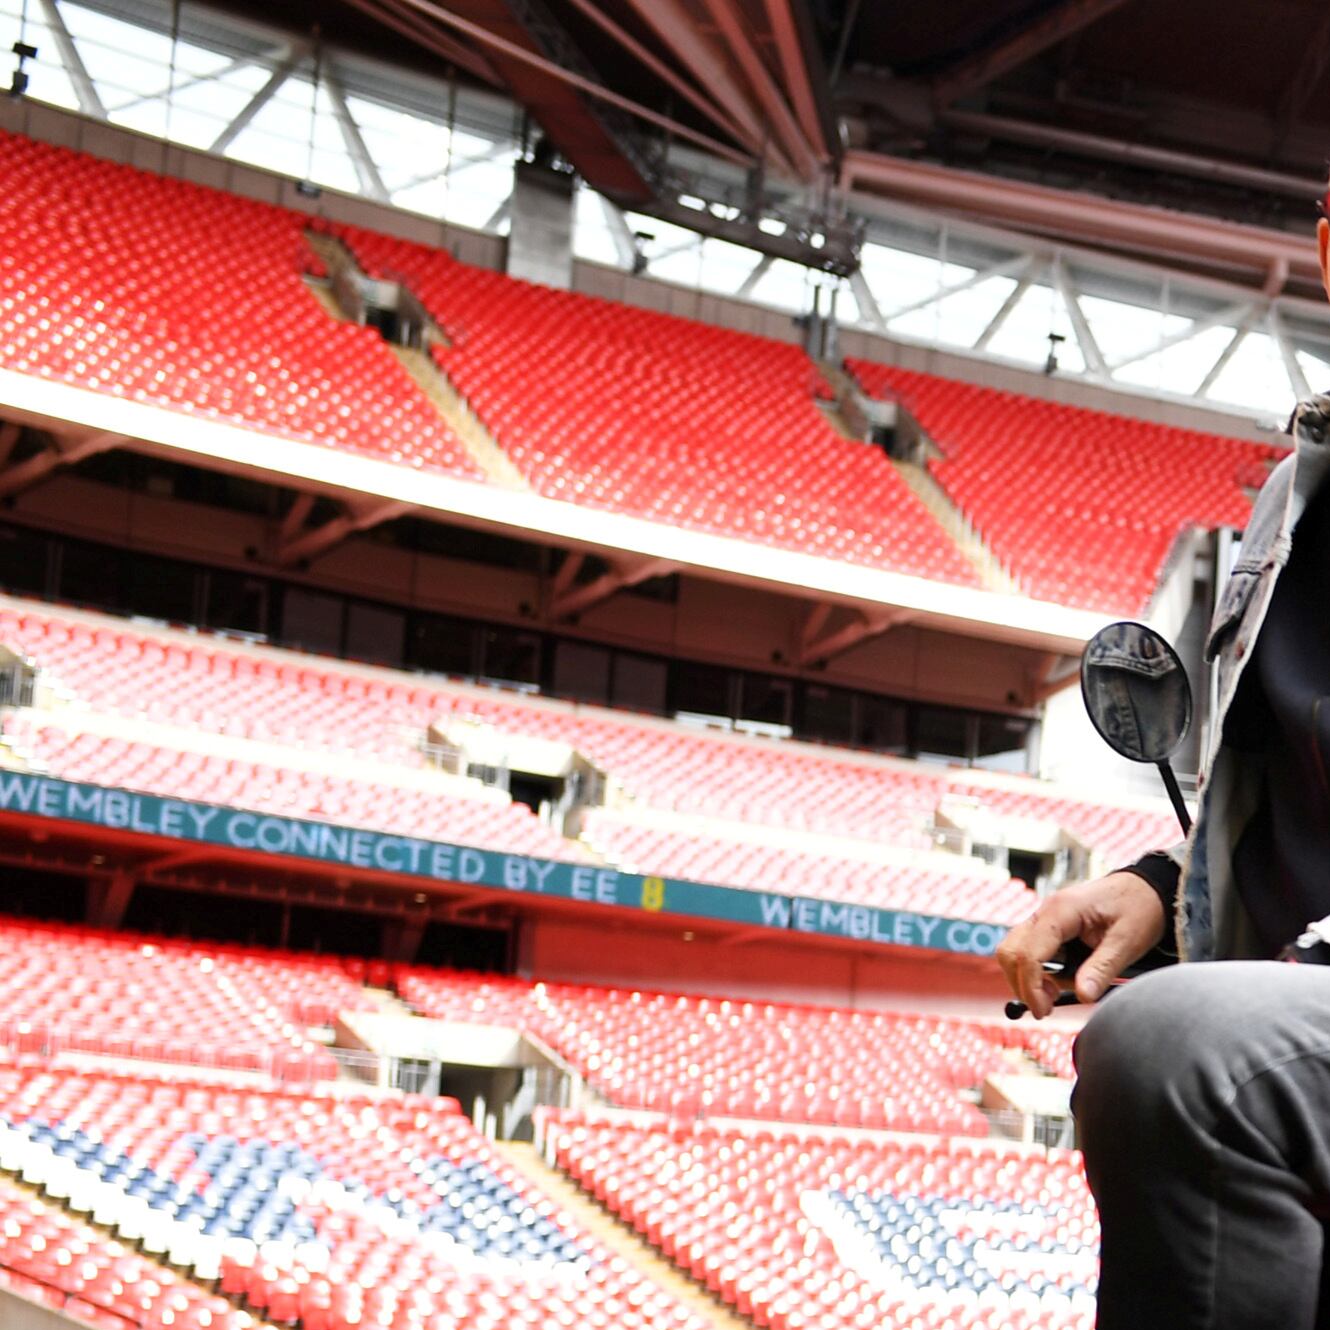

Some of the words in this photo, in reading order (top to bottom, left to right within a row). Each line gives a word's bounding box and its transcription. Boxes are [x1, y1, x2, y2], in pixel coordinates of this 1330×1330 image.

[0, 774, 220, 840] WEMBLEY
[227, 812, 486, 884] CONNECTED
[504, 856, 557, 888] BY
[571, 866, 618, 905] EE
[760, 894, 941, 946] WEMBLEY
